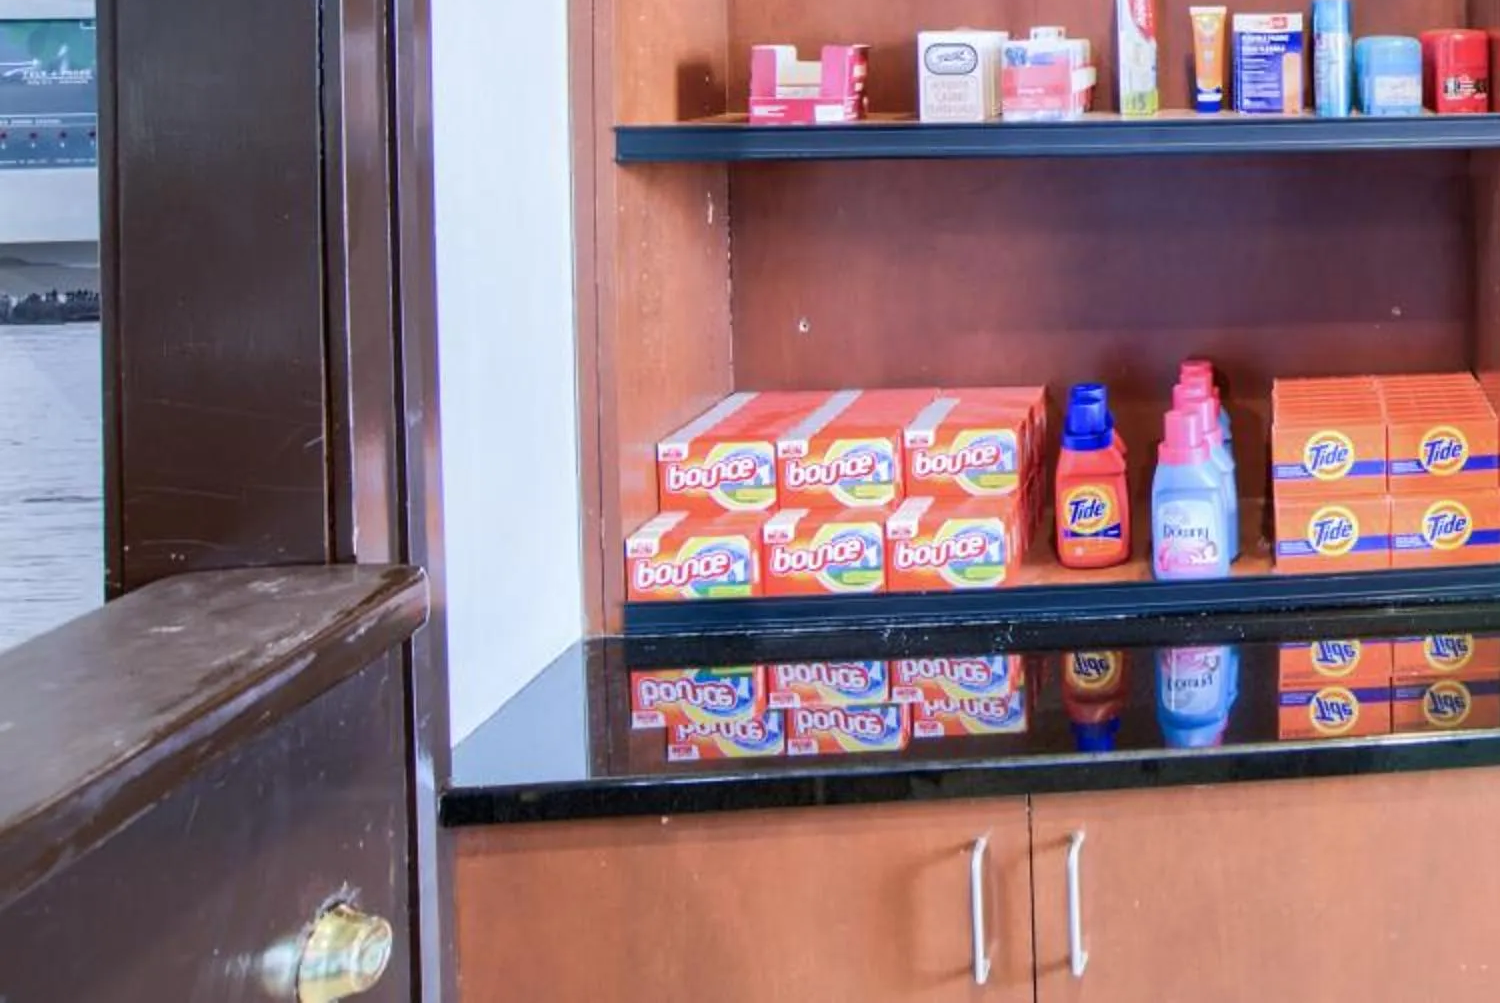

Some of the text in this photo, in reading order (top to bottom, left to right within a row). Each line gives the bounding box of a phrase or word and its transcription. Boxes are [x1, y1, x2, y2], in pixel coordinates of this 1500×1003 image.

[914, 444, 998, 474] bounce
[1309, 443, 1348, 472] Tide
[1424, 439, 1463, 467] Tide
[667, 459, 756, 491] bounce
[787, 453, 874, 486] bounce
[1069, 498, 1105, 524] Tide
[1314, 519, 1353, 547] Tide
[1428, 514, 1467, 541] Tide
[772, 538, 863, 571] bounce
[898, 534, 985, 567] bounce
[636, 553, 730, 588] bounce
